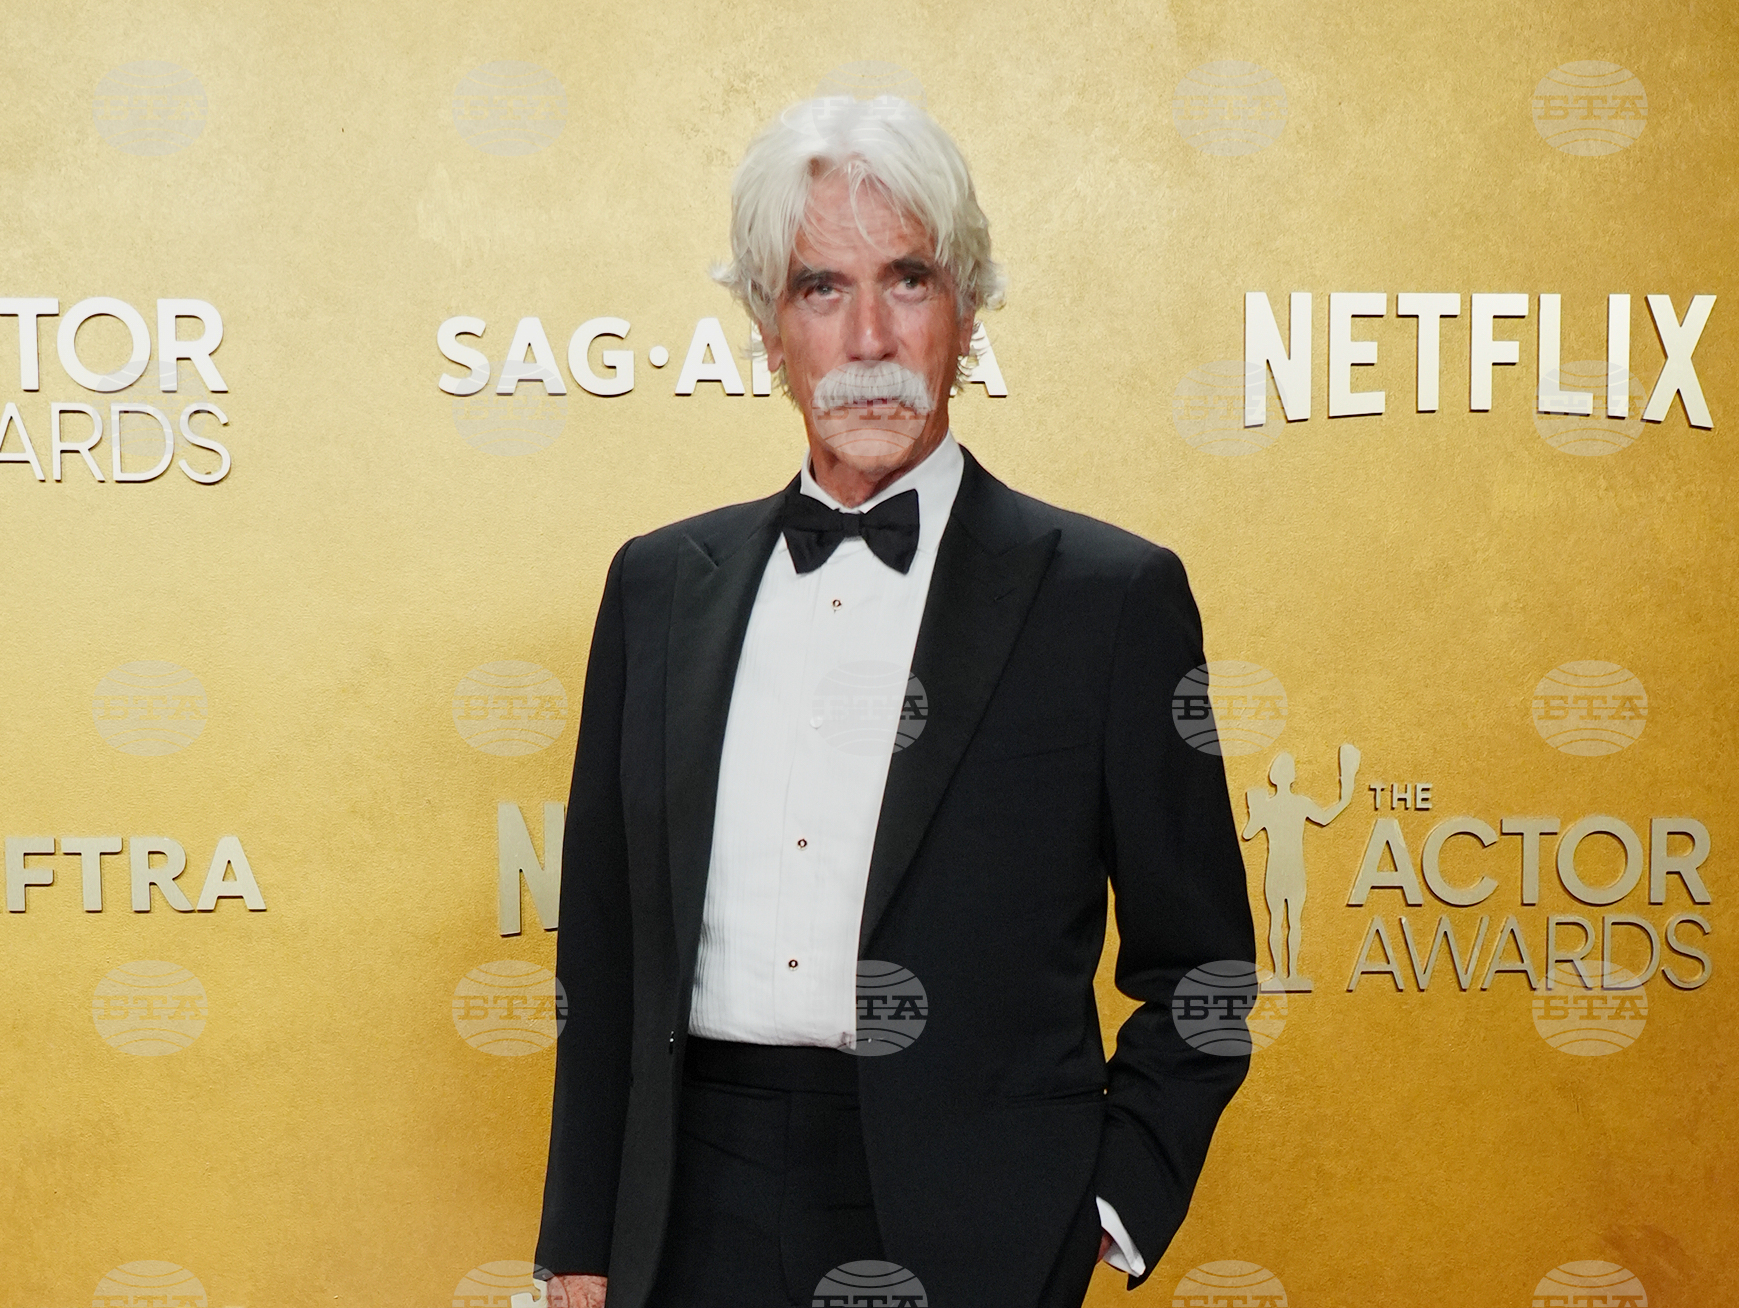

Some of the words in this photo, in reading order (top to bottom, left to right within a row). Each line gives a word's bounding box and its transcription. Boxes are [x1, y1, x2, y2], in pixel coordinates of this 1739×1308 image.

[0, 296, 229, 393] TOR
[1245, 291, 1718, 429] NETFLIX
[1369, 782, 1433, 810] THE
[5, 835, 267, 913] FTRA
[1347, 816, 1712, 907] ACTOR
[1346, 914, 1713, 991] AWARDS
